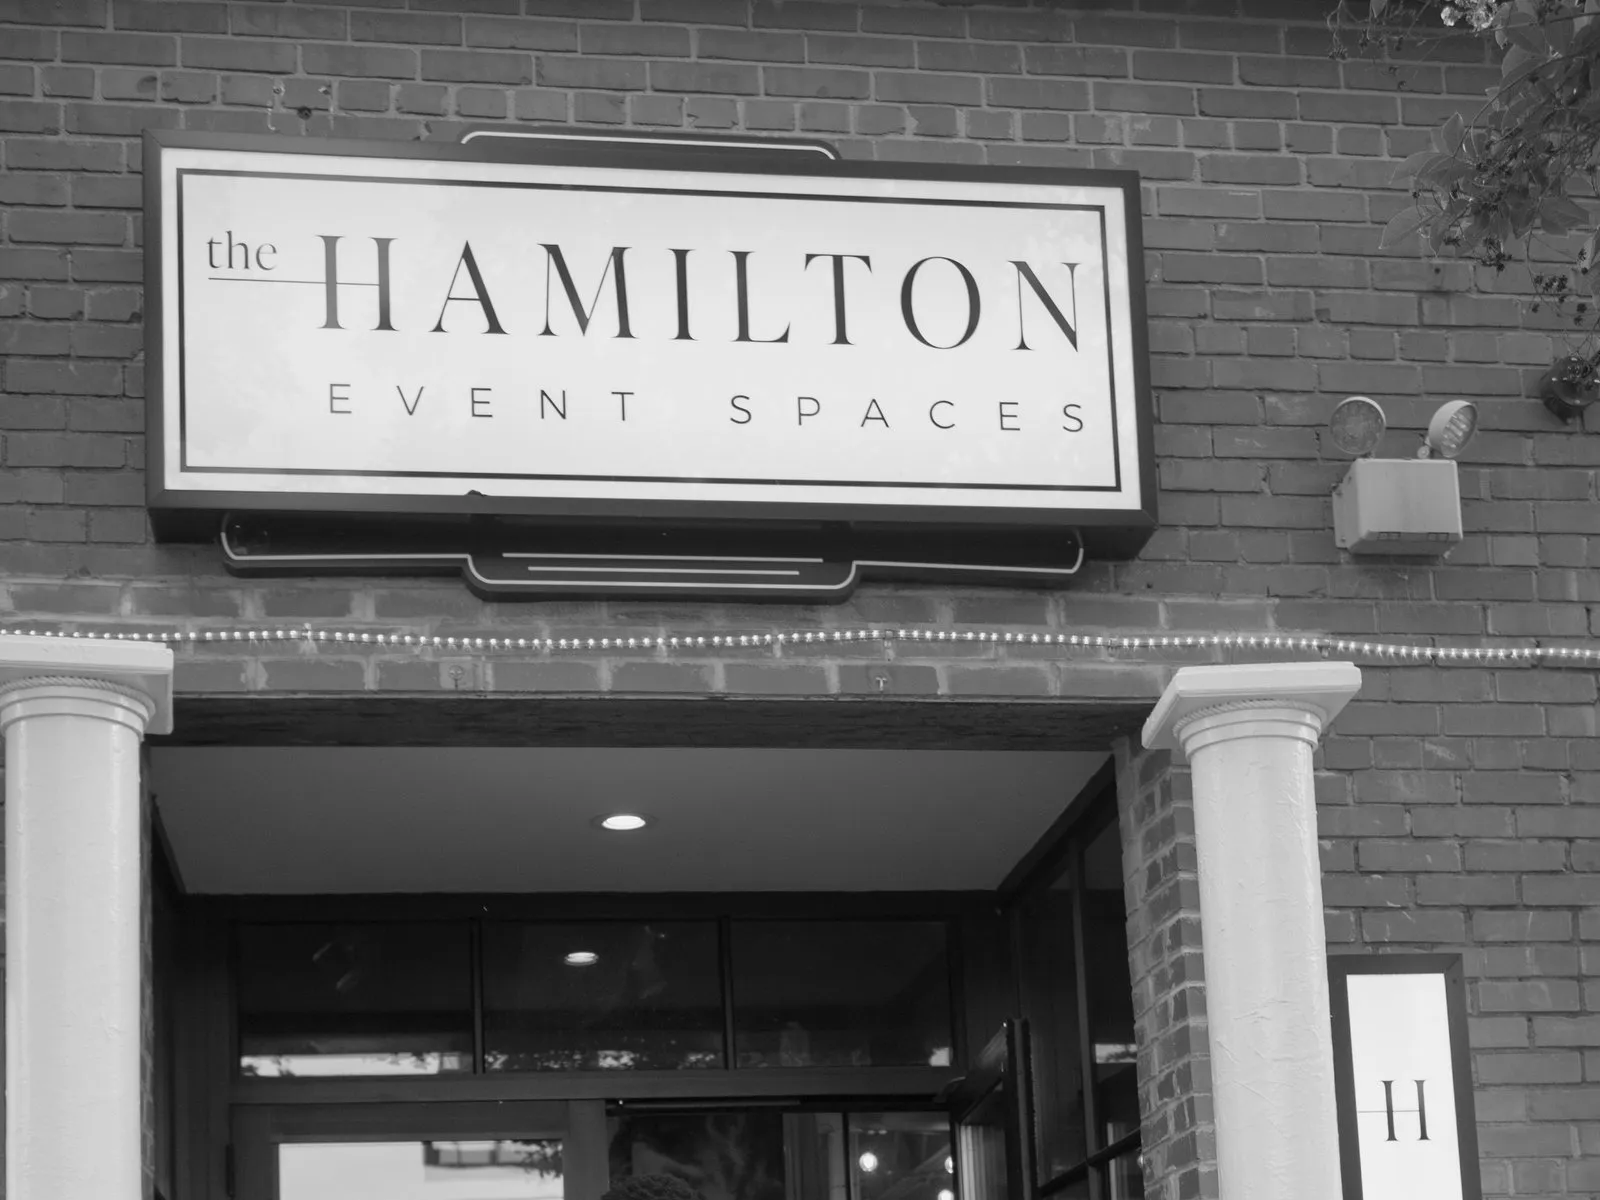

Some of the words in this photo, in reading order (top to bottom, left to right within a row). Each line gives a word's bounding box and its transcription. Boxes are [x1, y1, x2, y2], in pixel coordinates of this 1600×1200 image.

[207, 231, 278, 271] the
[315, 233, 1082, 353] HAMILTON
[329, 383, 635, 421] EVENT
[730, 394, 1084, 433] SPACES
[1380, 1079, 1431, 1142] H
